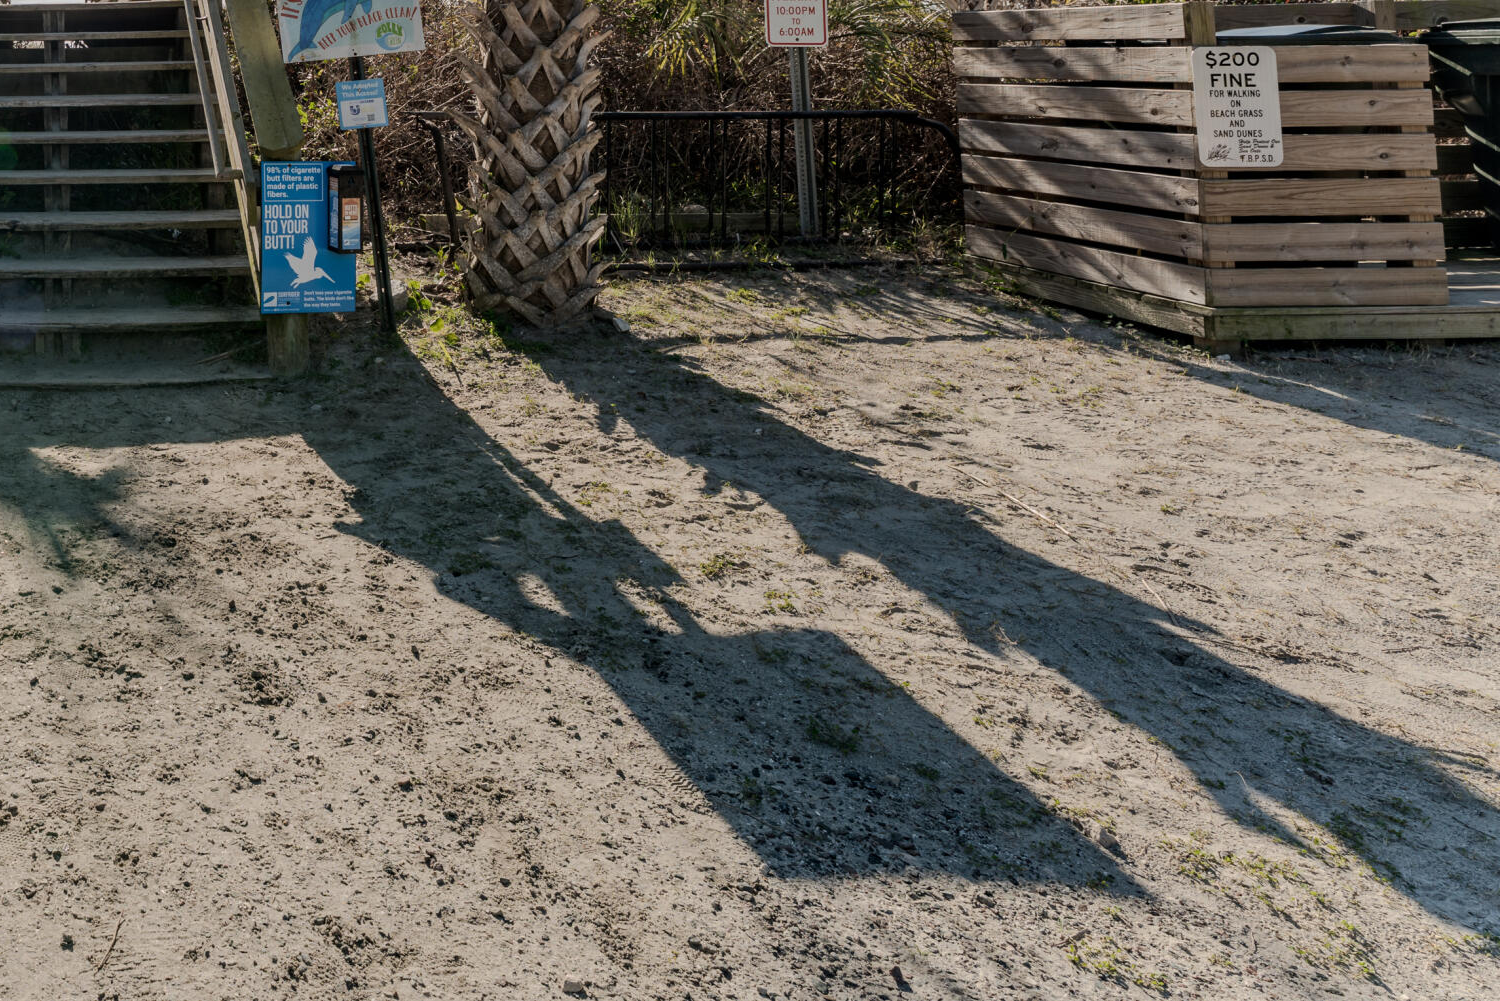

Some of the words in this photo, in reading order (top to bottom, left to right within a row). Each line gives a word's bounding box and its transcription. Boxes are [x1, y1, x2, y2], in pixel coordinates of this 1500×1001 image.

[776, 6, 816, 16] 10:00PM
[779, 27, 814, 37] 6:00AM
[1206, 50, 1260, 69] $200
[1210, 73, 1257, 87] FINE
[1238, 109, 1263, 117] GRASS
[1213, 130, 1234, 138] SAND
[1237, 130, 1263, 138] DUNES
[266, 166, 280, 174] 98%
[282, 166, 290, 174] of
[290, 166, 321, 175] cigarette
[266, 174, 281, 182] butt
[282, 174, 302, 182] filters
[296, 183, 318, 191] plastic
[264, 204, 292, 219] HOLD
[294, 204, 309, 219] ON
[264, 219, 279, 234] TO
[280, 220, 308, 234] YOUR
[264, 235, 294, 250] BUTT!
